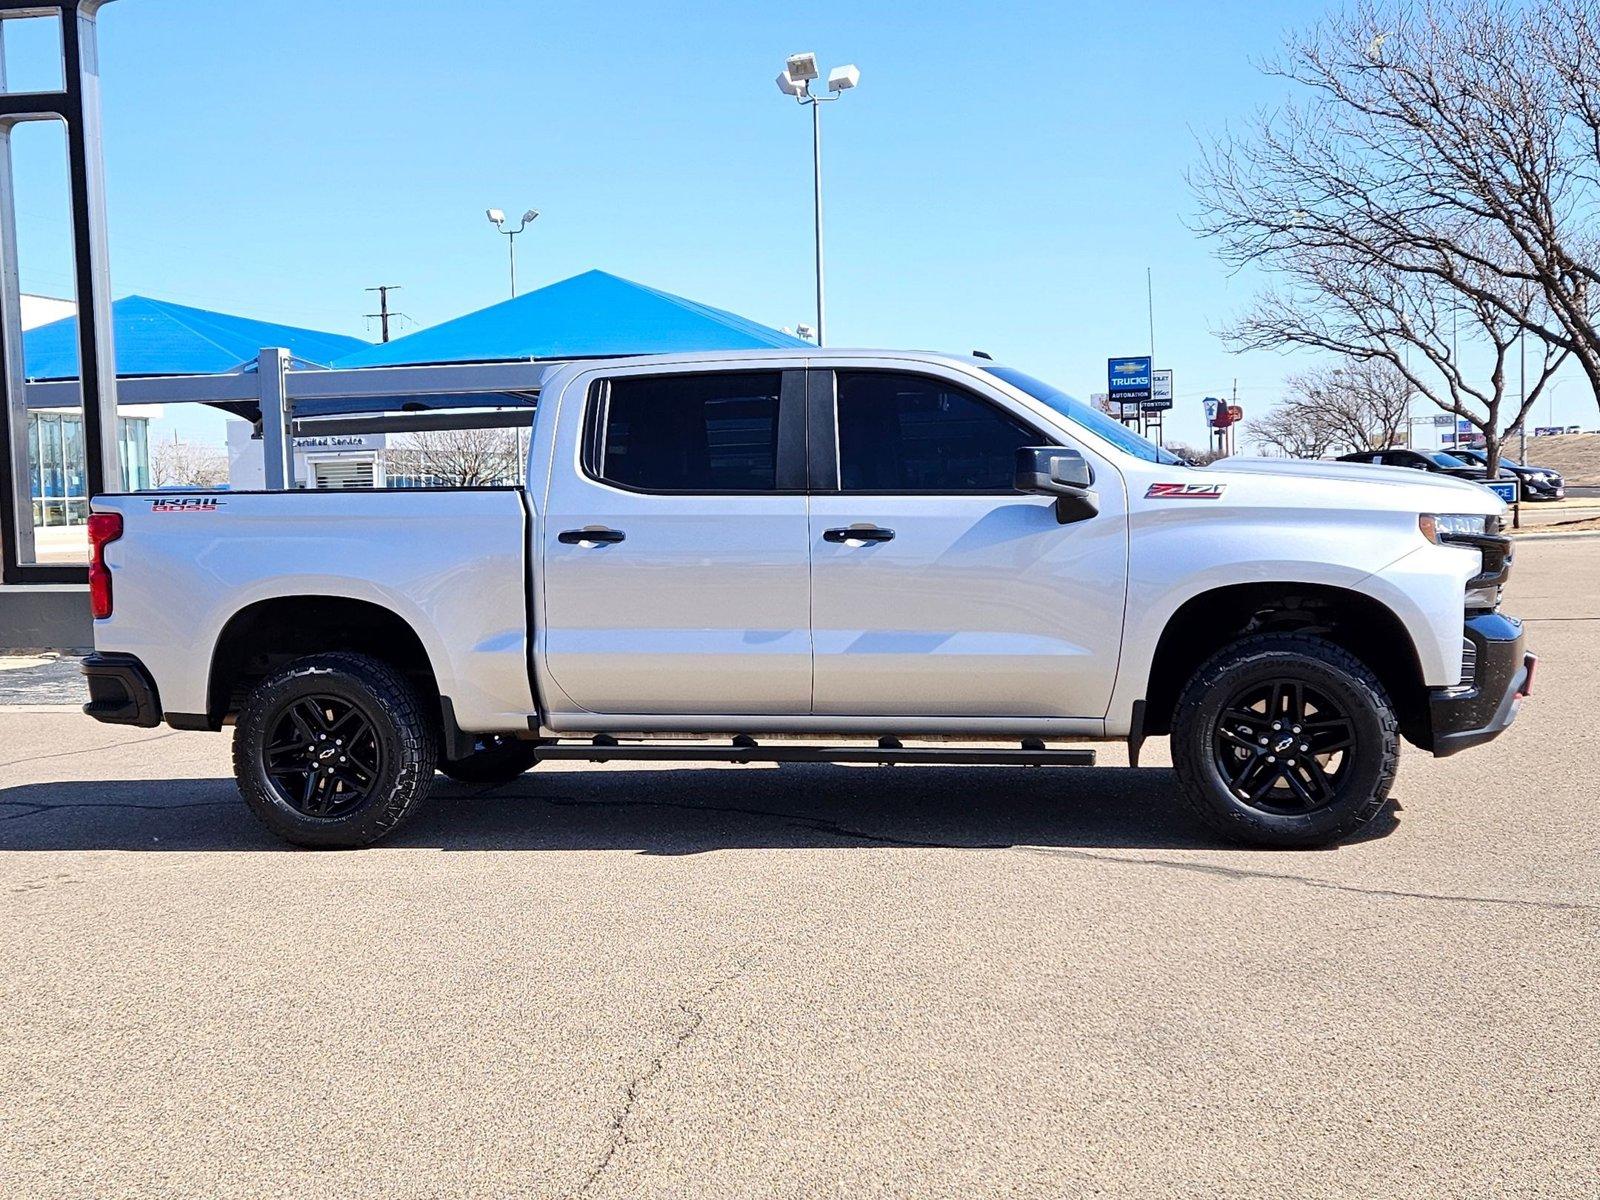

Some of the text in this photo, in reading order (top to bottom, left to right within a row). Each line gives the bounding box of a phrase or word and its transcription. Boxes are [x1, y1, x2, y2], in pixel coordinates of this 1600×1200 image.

[1111, 377, 1148, 385] TRUCKS
[293, 436, 363, 447] Certified Service
[1144, 482, 1227, 500] Z71
[1495, 488, 1511, 498] CE
[144, 498, 228, 506] TRAIL
